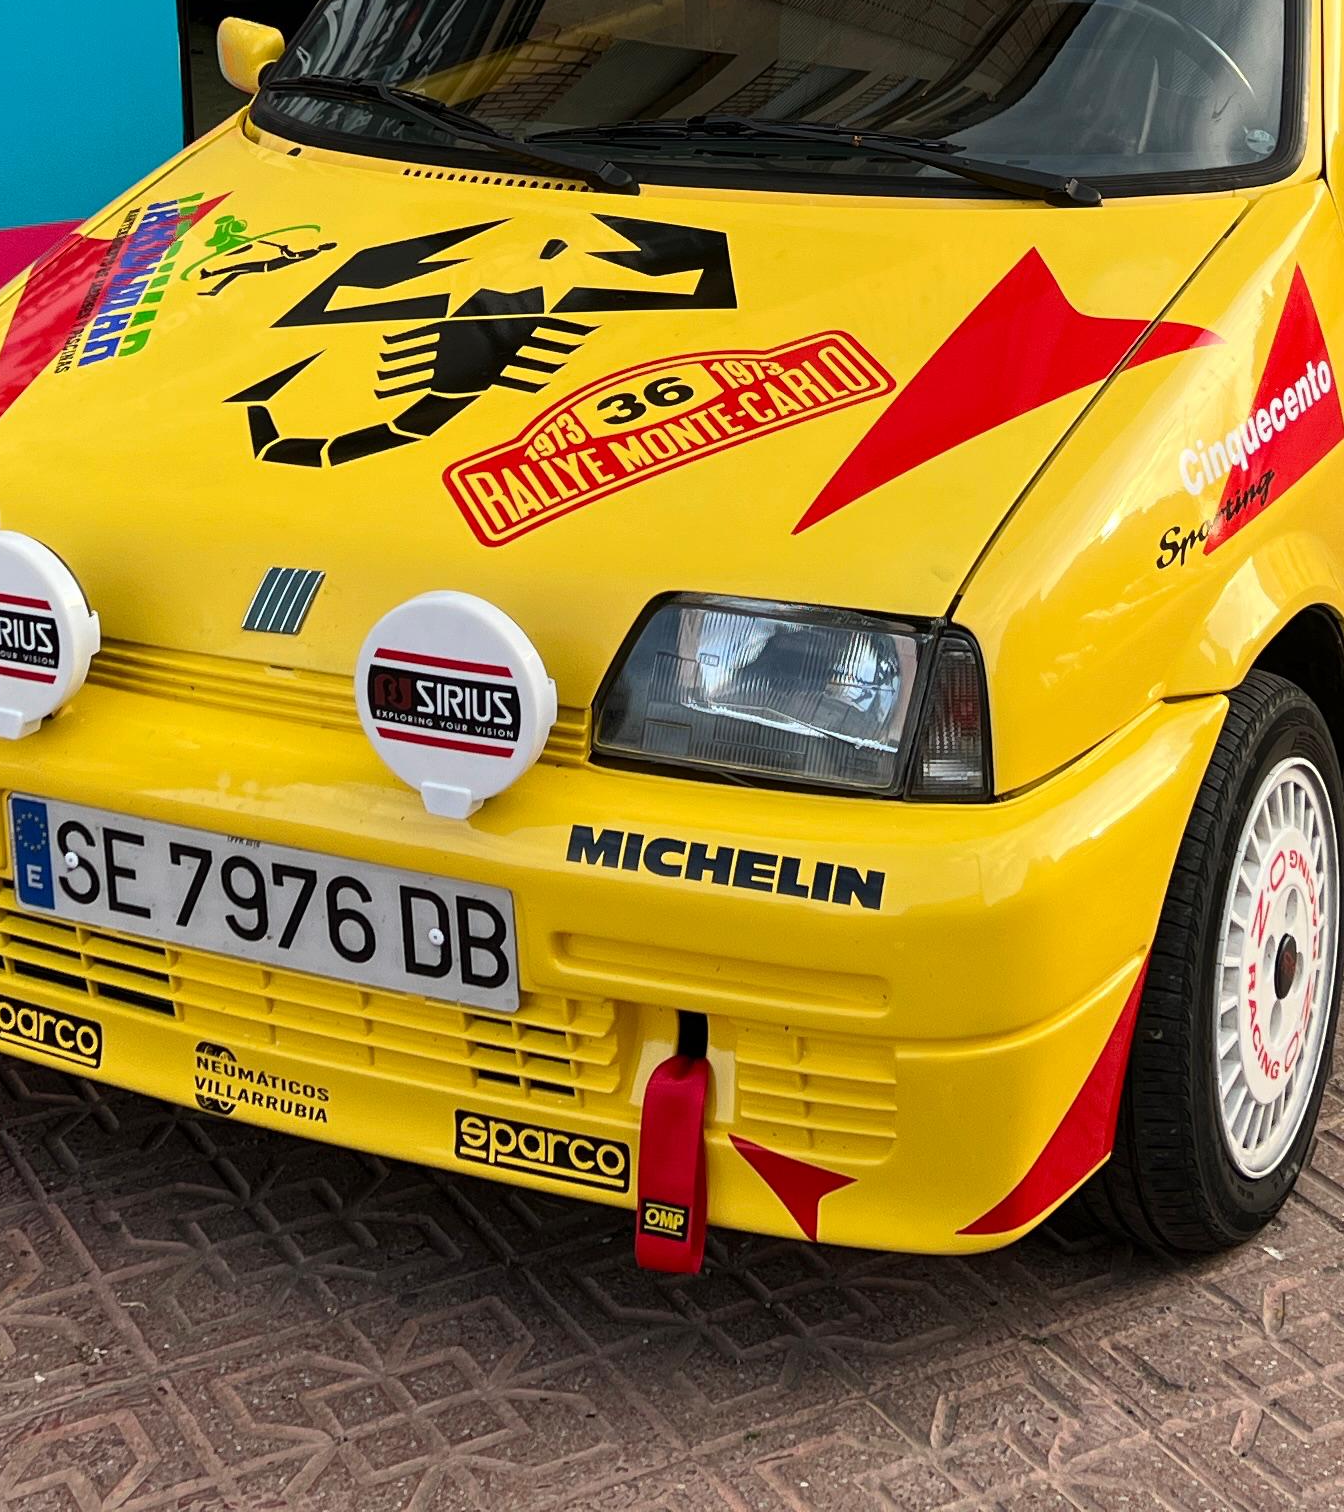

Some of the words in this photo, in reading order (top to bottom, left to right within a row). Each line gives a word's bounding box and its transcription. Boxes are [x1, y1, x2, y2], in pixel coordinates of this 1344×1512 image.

[54, 327, 84, 375] PISCINAS
[523, 411, 587, 463] 1973
[595, 376, 695, 426] 36
[709, 359, 785, 390] 1973
[1178, 359, 1333, 497] Cinquecento
[464, 447, 616, 531] RALLYE
[608, 344, 867, 474] MONTE-CARLO
[22, 653, 55, 666] VISION
[375, 708, 434, 727] EXPLORING
[439, 719, 468, 733] YOUR
[474, 725, 514, 739] VISION
[415, 679, 513, 726] SIRIUS
[565, 823, 887, 911] MICHELIN
[26, 864, 44, 889] E
[56, 820, 152, 920] SE
[168, 842, 378, 964] 7976
[398, 884, 511, 990] DB
[194, 1074, 329, 1124] VILLARRUBIA
[196, 1055, 330, 1102] NEUMÁTICOS
[459, 1114, 626, 1178] sparco
[644, 1207, 685, 1231] OMP
